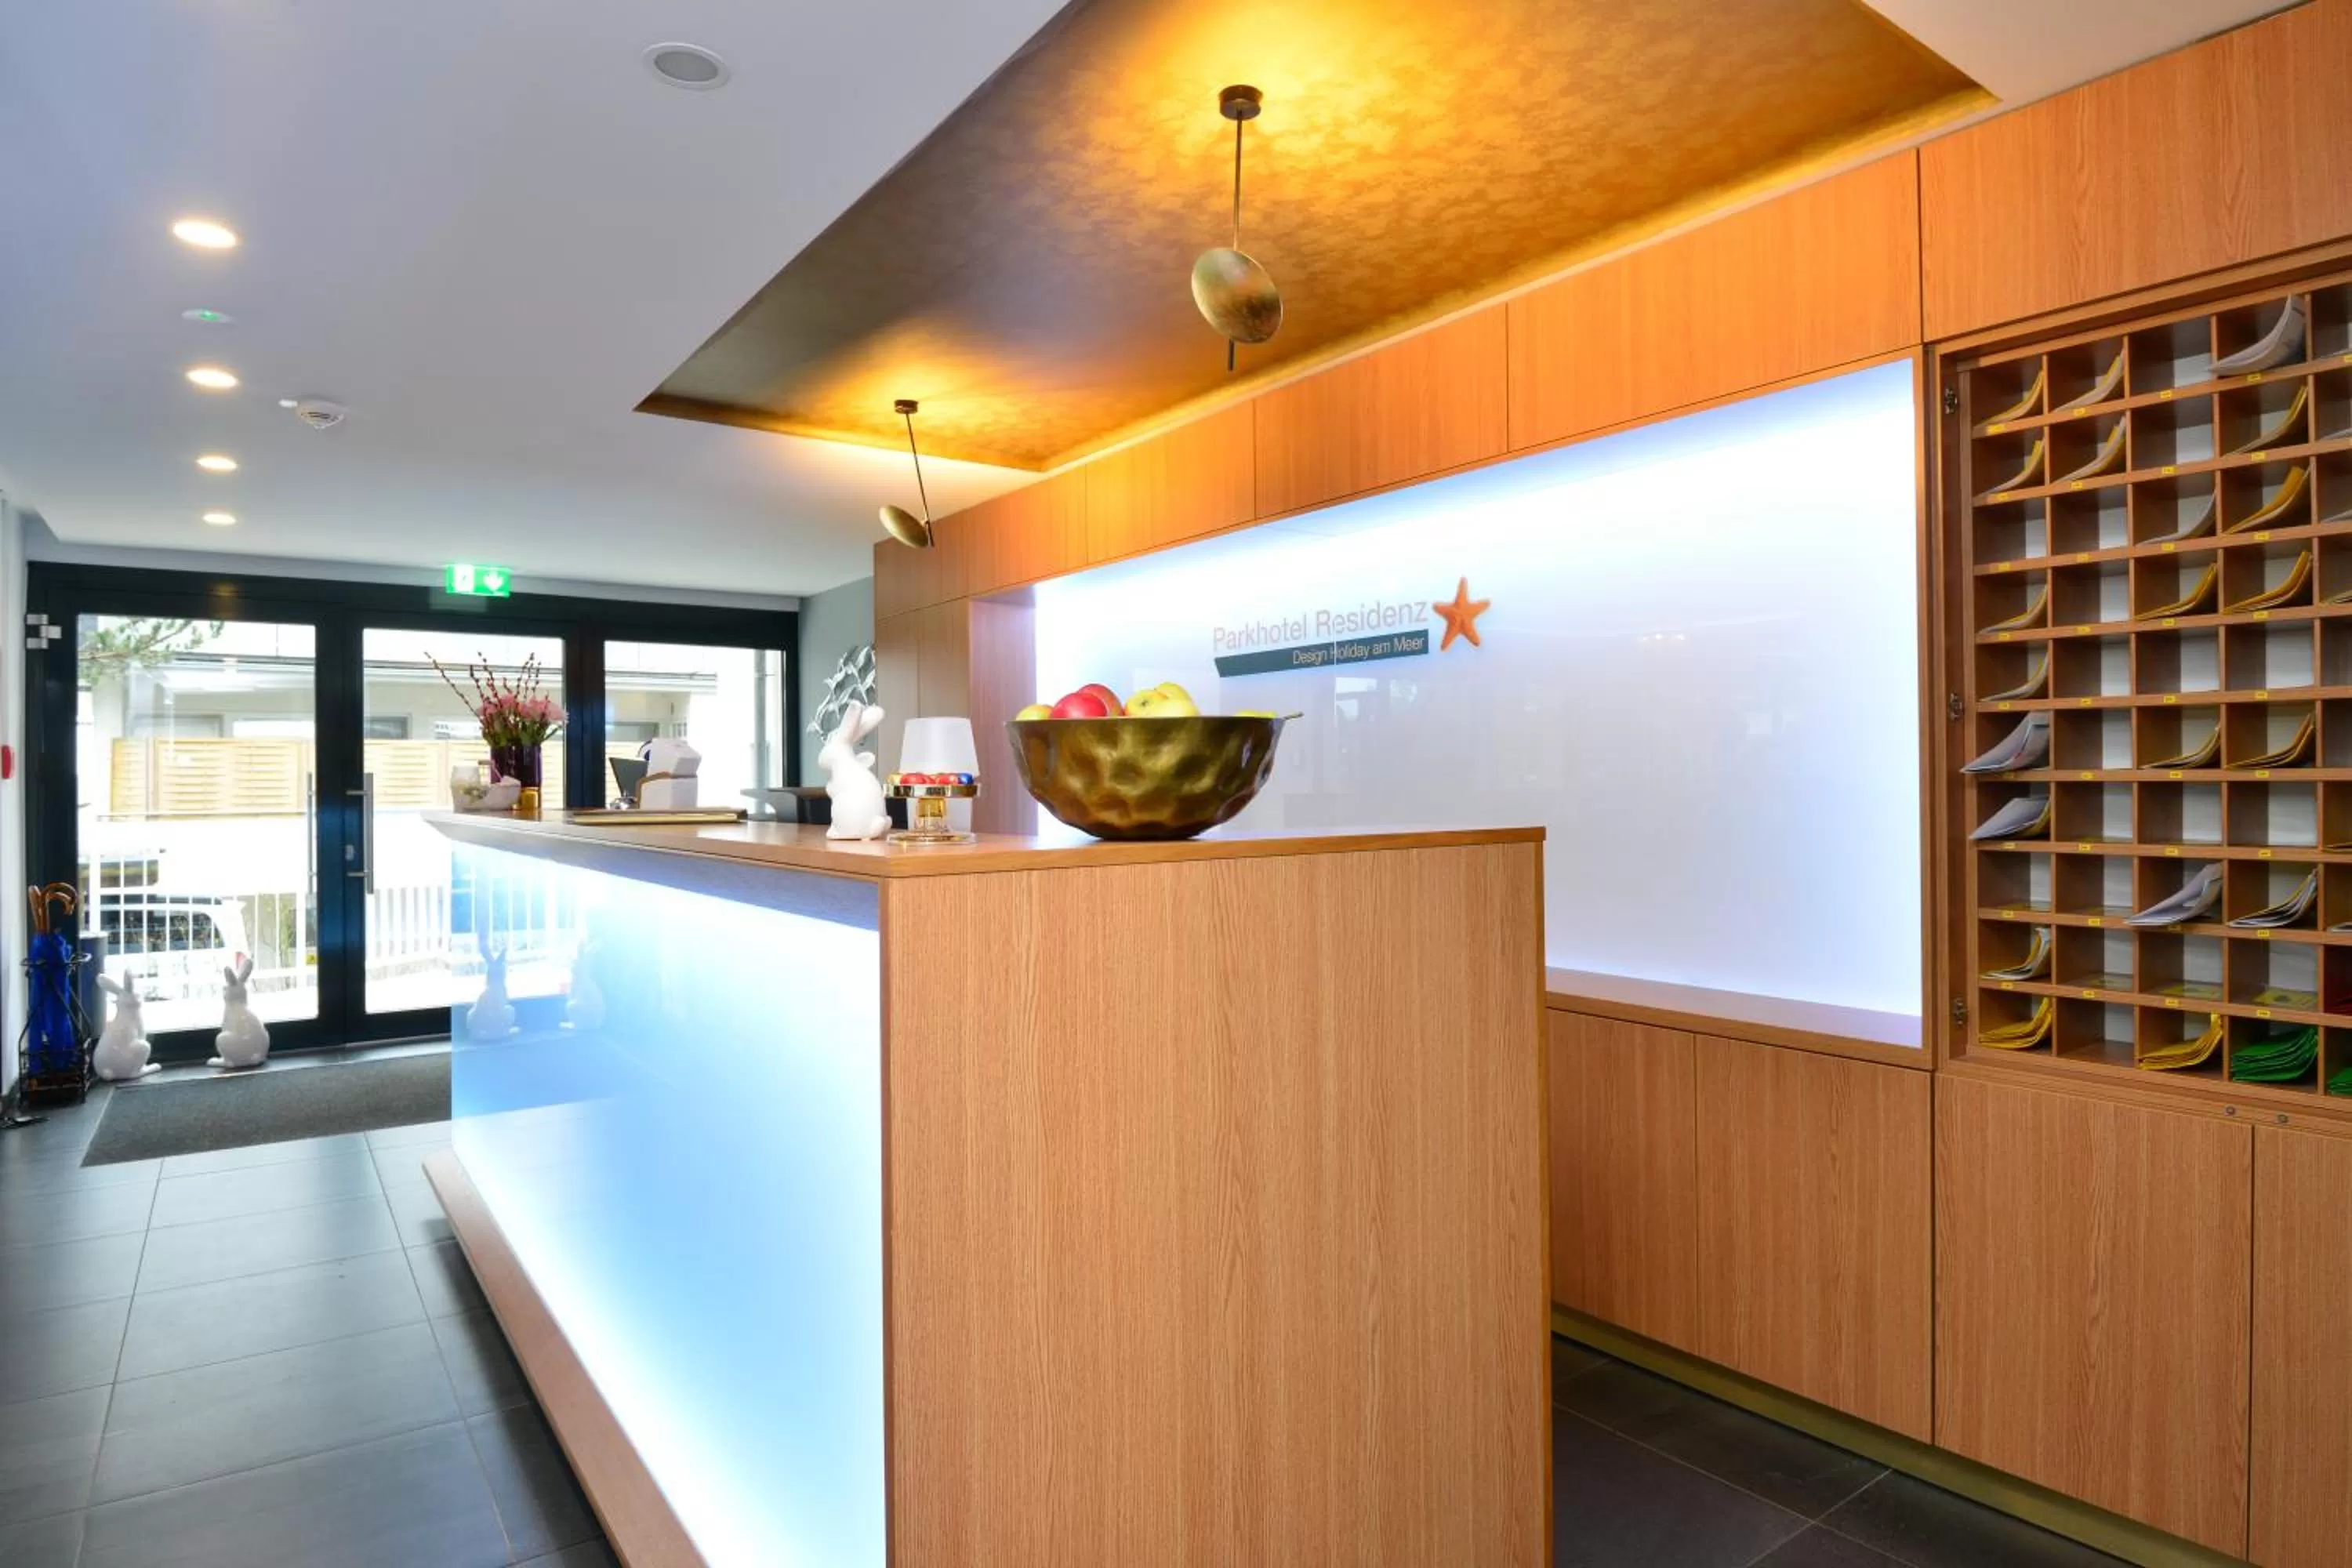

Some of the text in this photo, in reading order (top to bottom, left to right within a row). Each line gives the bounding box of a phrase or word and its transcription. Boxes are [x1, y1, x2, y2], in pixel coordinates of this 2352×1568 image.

[1214, 600, 1428, 652] Parkhotel Residenz
[1293, 636, 1425, 665] Design Holiday am Meer
